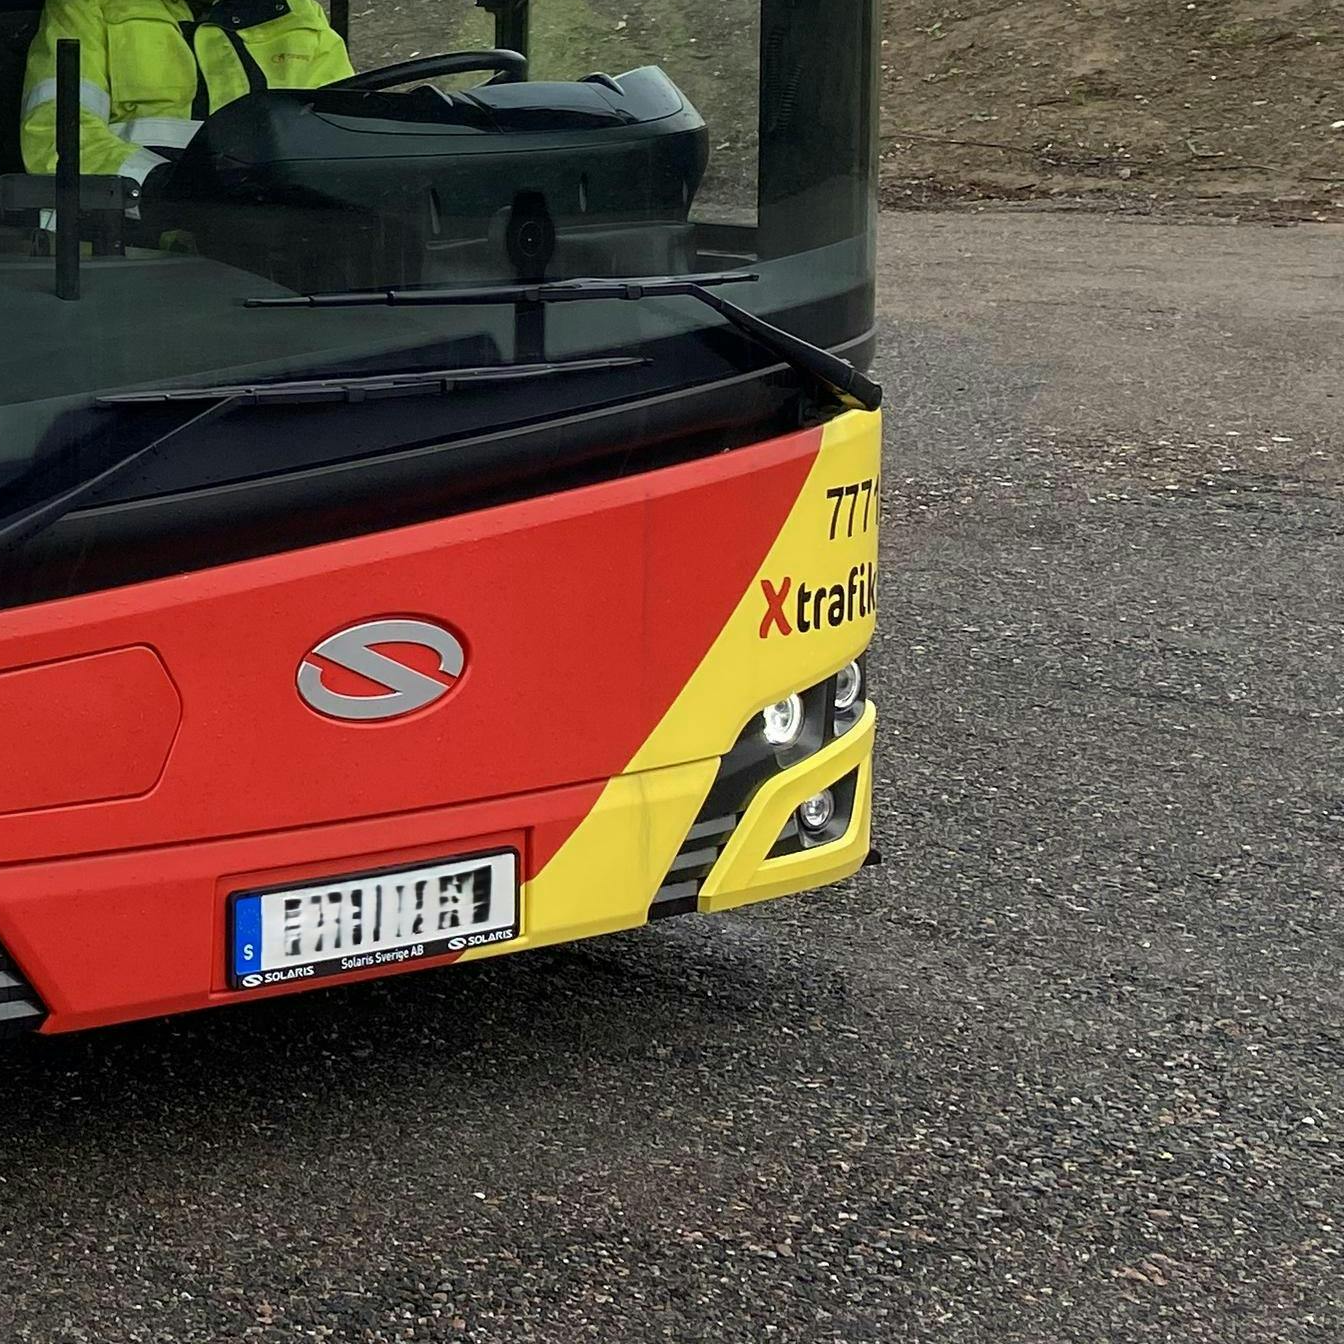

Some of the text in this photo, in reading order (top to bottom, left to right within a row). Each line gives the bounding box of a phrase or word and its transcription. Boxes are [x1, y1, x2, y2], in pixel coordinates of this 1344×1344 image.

[467, 928, 513, 947] SOLARIS
[243, 944, 254, 960] S
[341, 945, 424, 970] Solaris Sverige AB
[264, 964, 315, 984] SOLARIS
